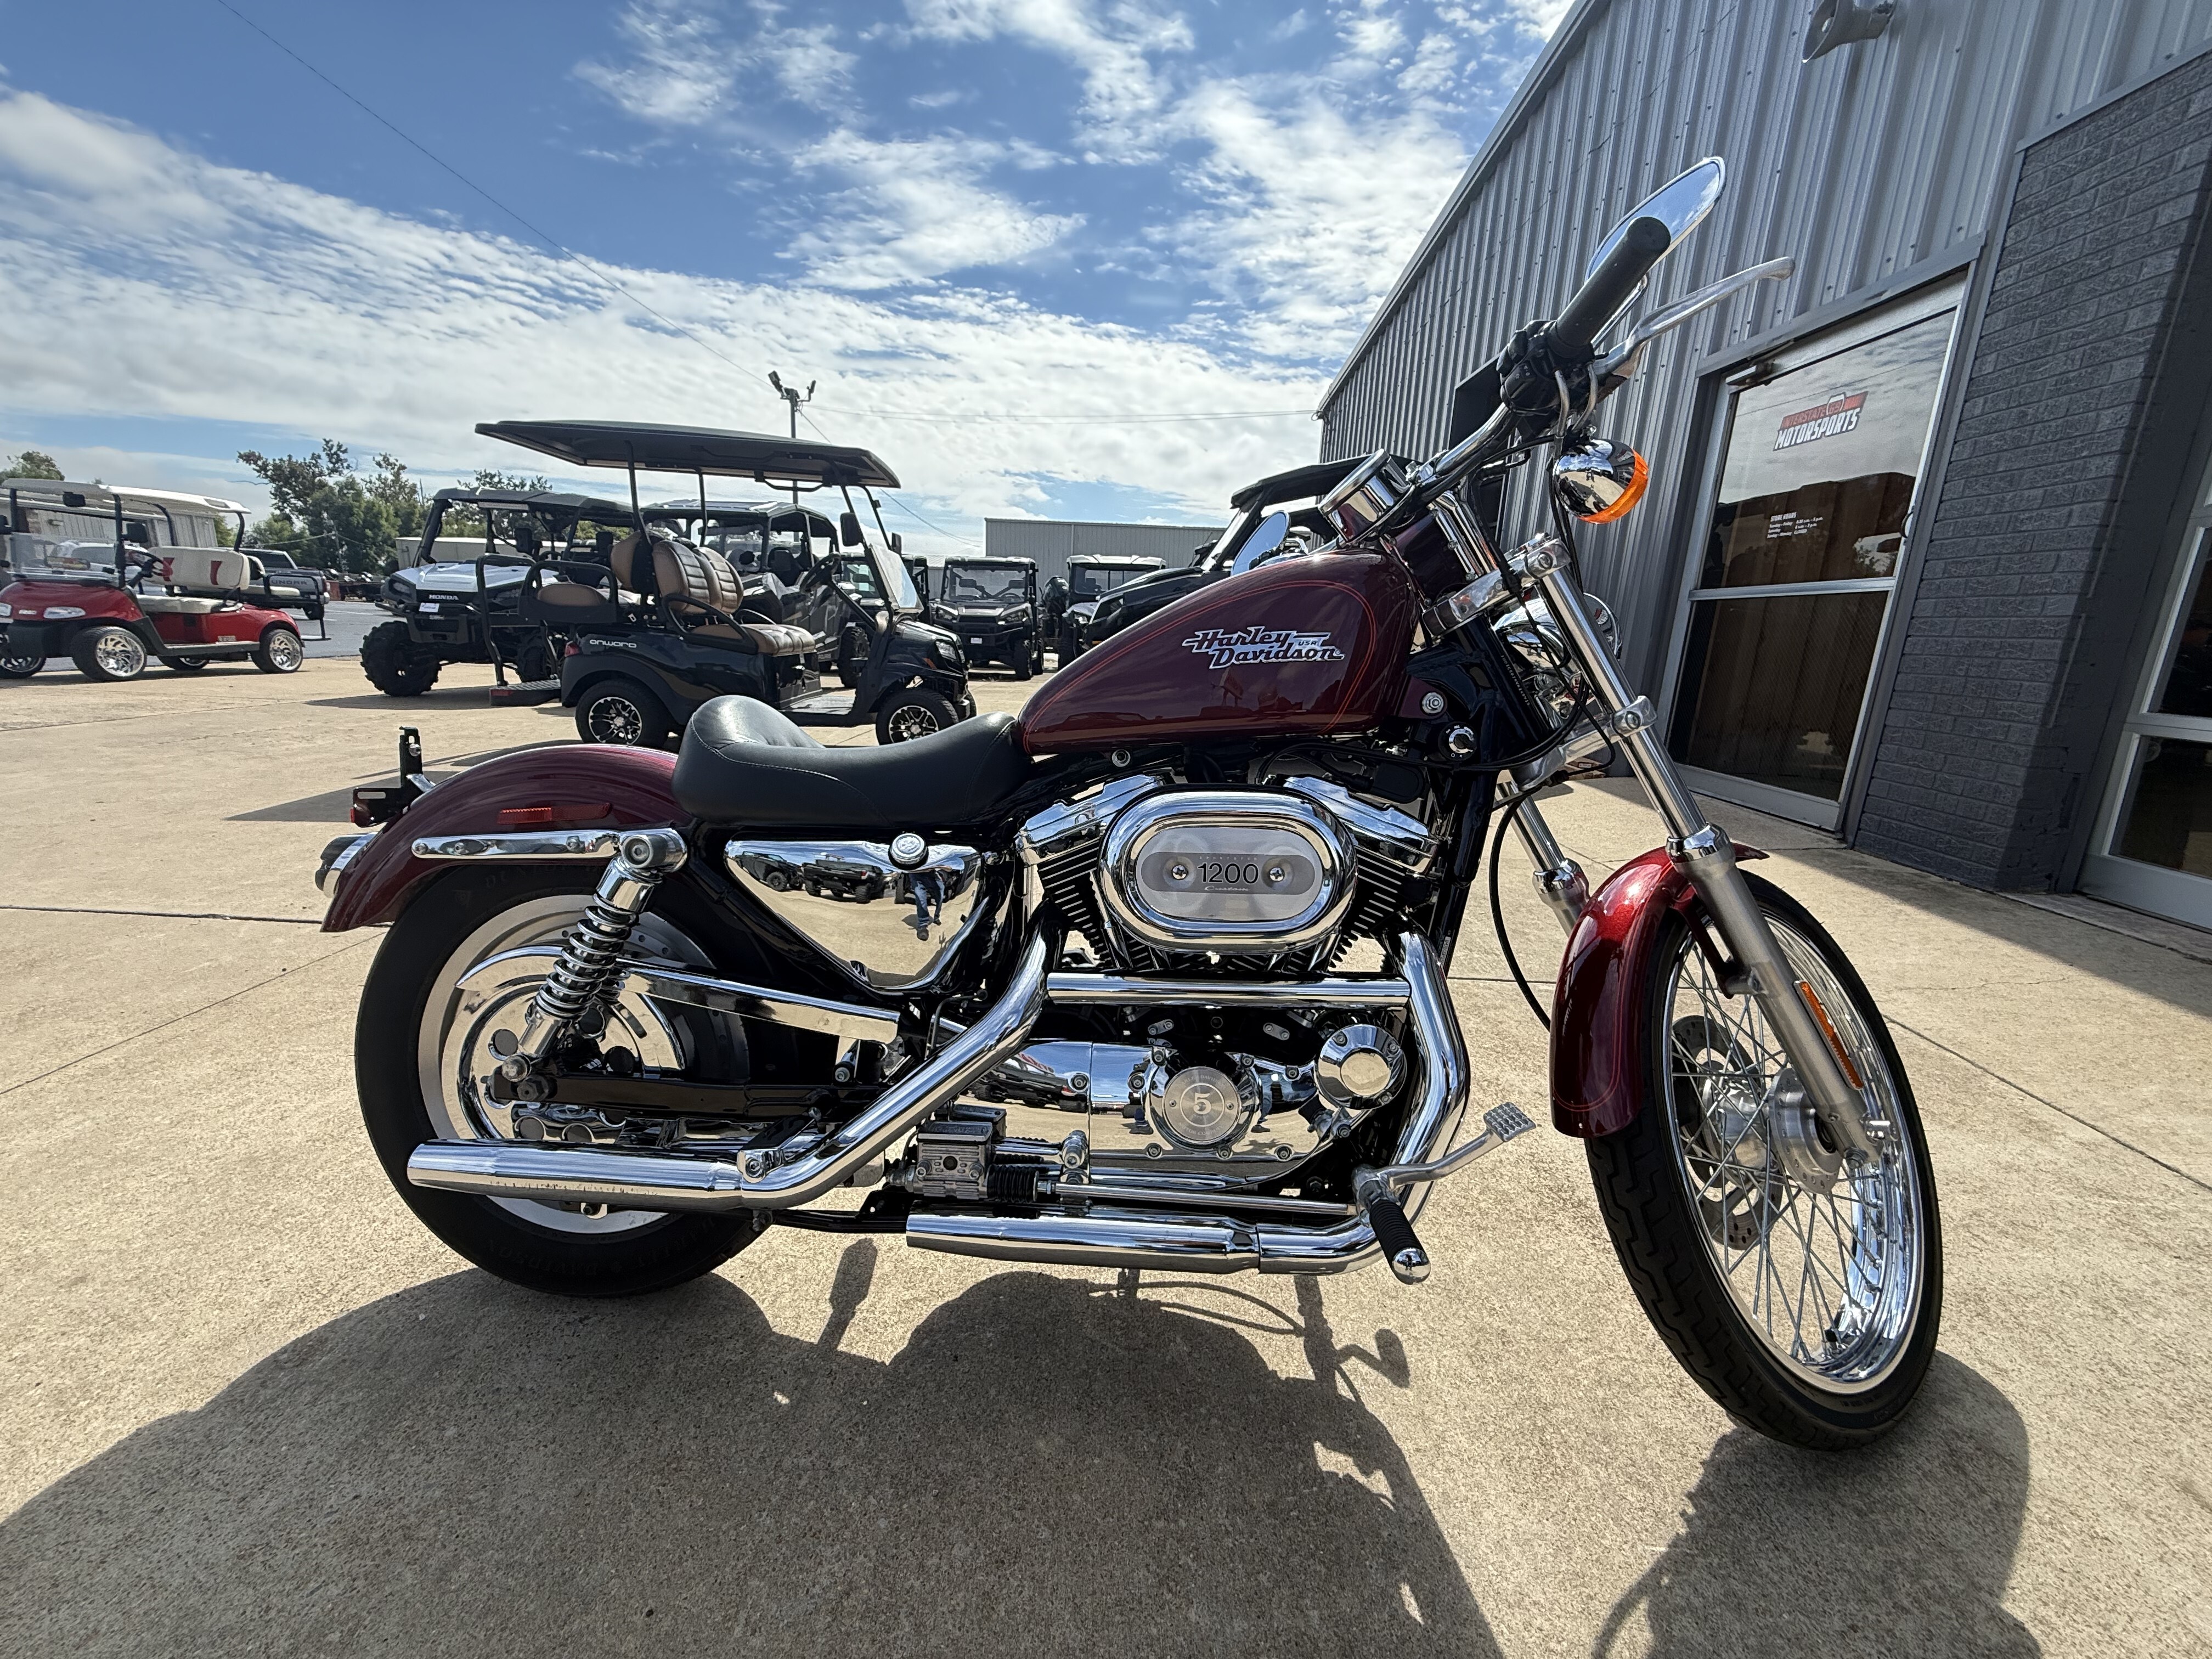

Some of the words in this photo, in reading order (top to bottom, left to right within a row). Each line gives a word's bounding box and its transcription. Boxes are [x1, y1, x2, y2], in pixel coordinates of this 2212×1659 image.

[1774, 408, 1861, 450] MOTORSPORTS
[1182, 626, 1298, 653] Harley
[1209, 643, 1344, 669] Davidson
[1197, 862, 1260, 885] 1200
[1193, 1092, 1211, 1114] 5
